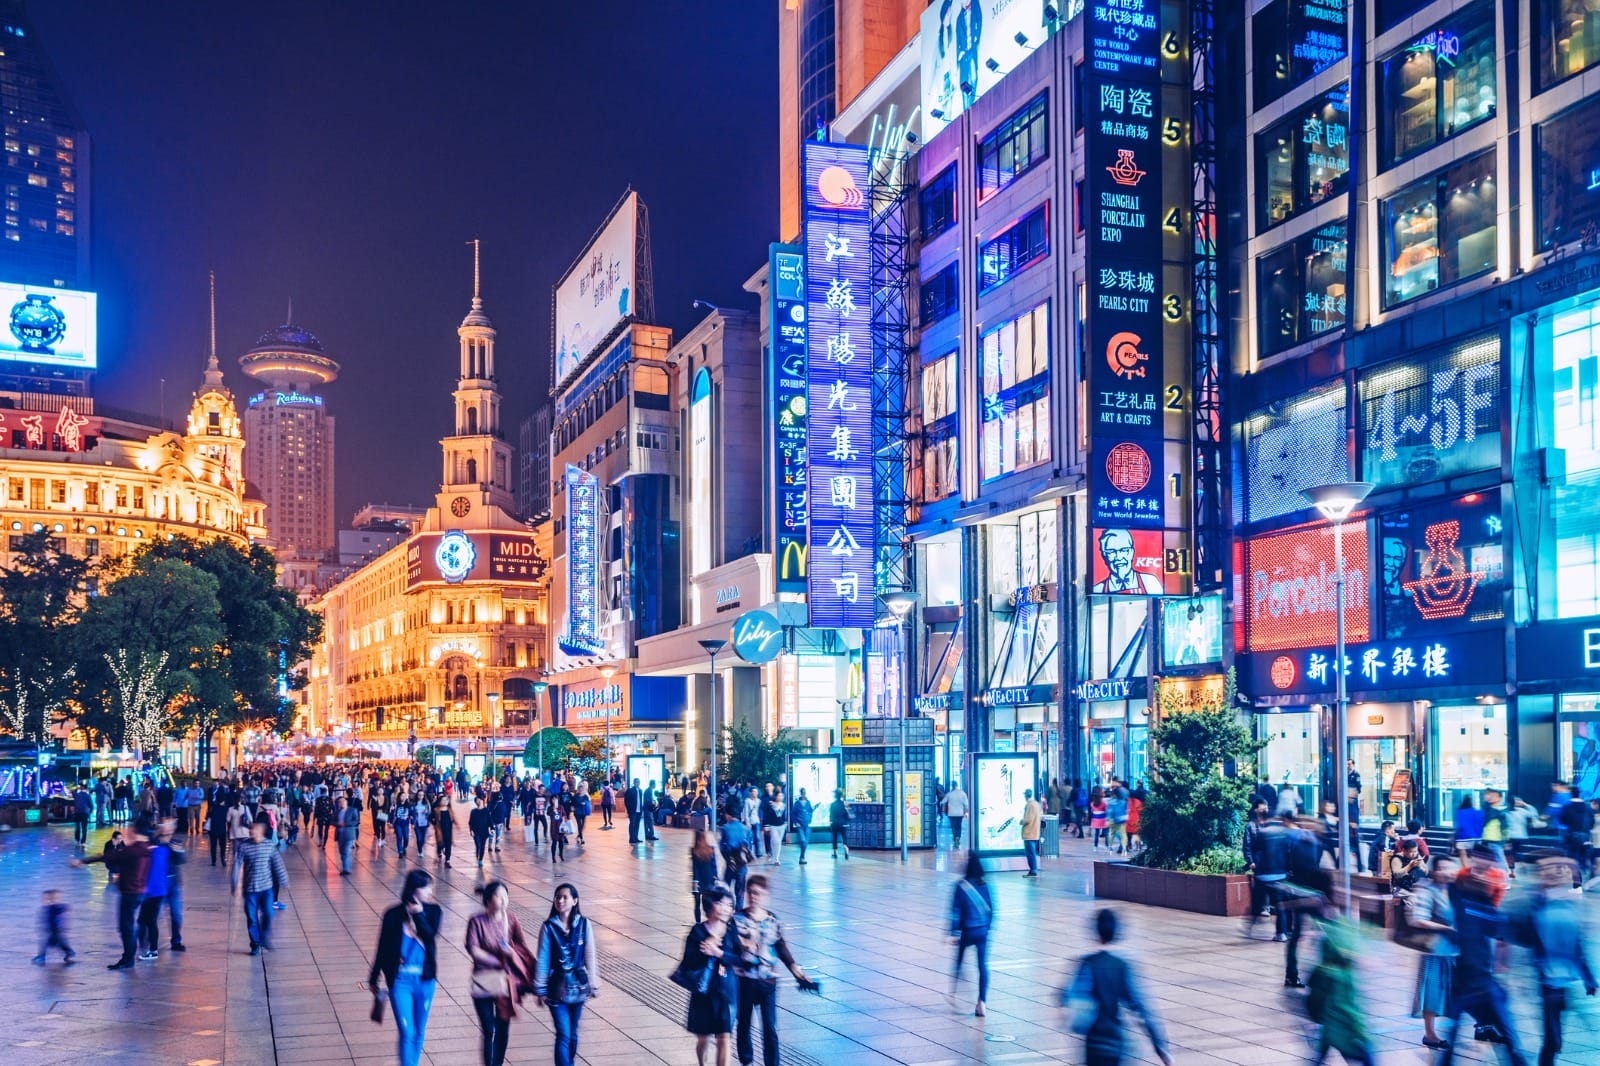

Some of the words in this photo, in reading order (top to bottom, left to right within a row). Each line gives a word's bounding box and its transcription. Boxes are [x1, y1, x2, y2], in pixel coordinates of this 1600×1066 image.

[1094, 6, 1156, 29] 现代珍藏品
[1114, 25, 1139, 41] 中心
[1094, 38, 1107, 47] NEW
[1109, 40, 1130, 51] WORLD
[1162, 31, 1180, 60] 6
[1094, 49, 1142, 64] CONTEMPORARY
[1144, 56, 1156, 67] ART
[1094, 60, 1119, 72] CENTER
[1100, 84, 1152, 118] 陶瓷
[1101, 120, 1149, 140] 精品商场
[1162, 117, 1181, 146] 5
[1101, 192, 1139, 210] SHANGHAI
[1101, 210, 1145, 228] PORCELAIN
[1162, 207, 1182, 233] 4
[1101, 226, 1121, 243] EXPO
[1100, 268, 1154, 293] 珍珠城
[1099, 295, 1127, 310] PEARLS
[1130, 298, 1149, 313] CITY
[1162, 294, 1182, 321] 3
[1100, 392, 1156, 410] 工艺礼品
[1163, 384, 1184, 412] 2
[824, 232, 860, 604] 江蘇陽光集團公司
[1101, 412, 1114, 423] ART
[1116, 413, 1122, 423] &
[1124, 413, 1151, 425] CRAFTS
[1167, 472, 1182, 498] 1
[1135, 557, 1162, 568] KFC
[1163, 548, 1190, 573] B1
[717, 585, 739, 603] ZARA
[736, 618, 783, 652] Lily
[987, 688, 1031, 706] ME&CITY
[1078, 681, 1130, 699] ME&CITY
[914, 695, 950, 710] ME&CITY
